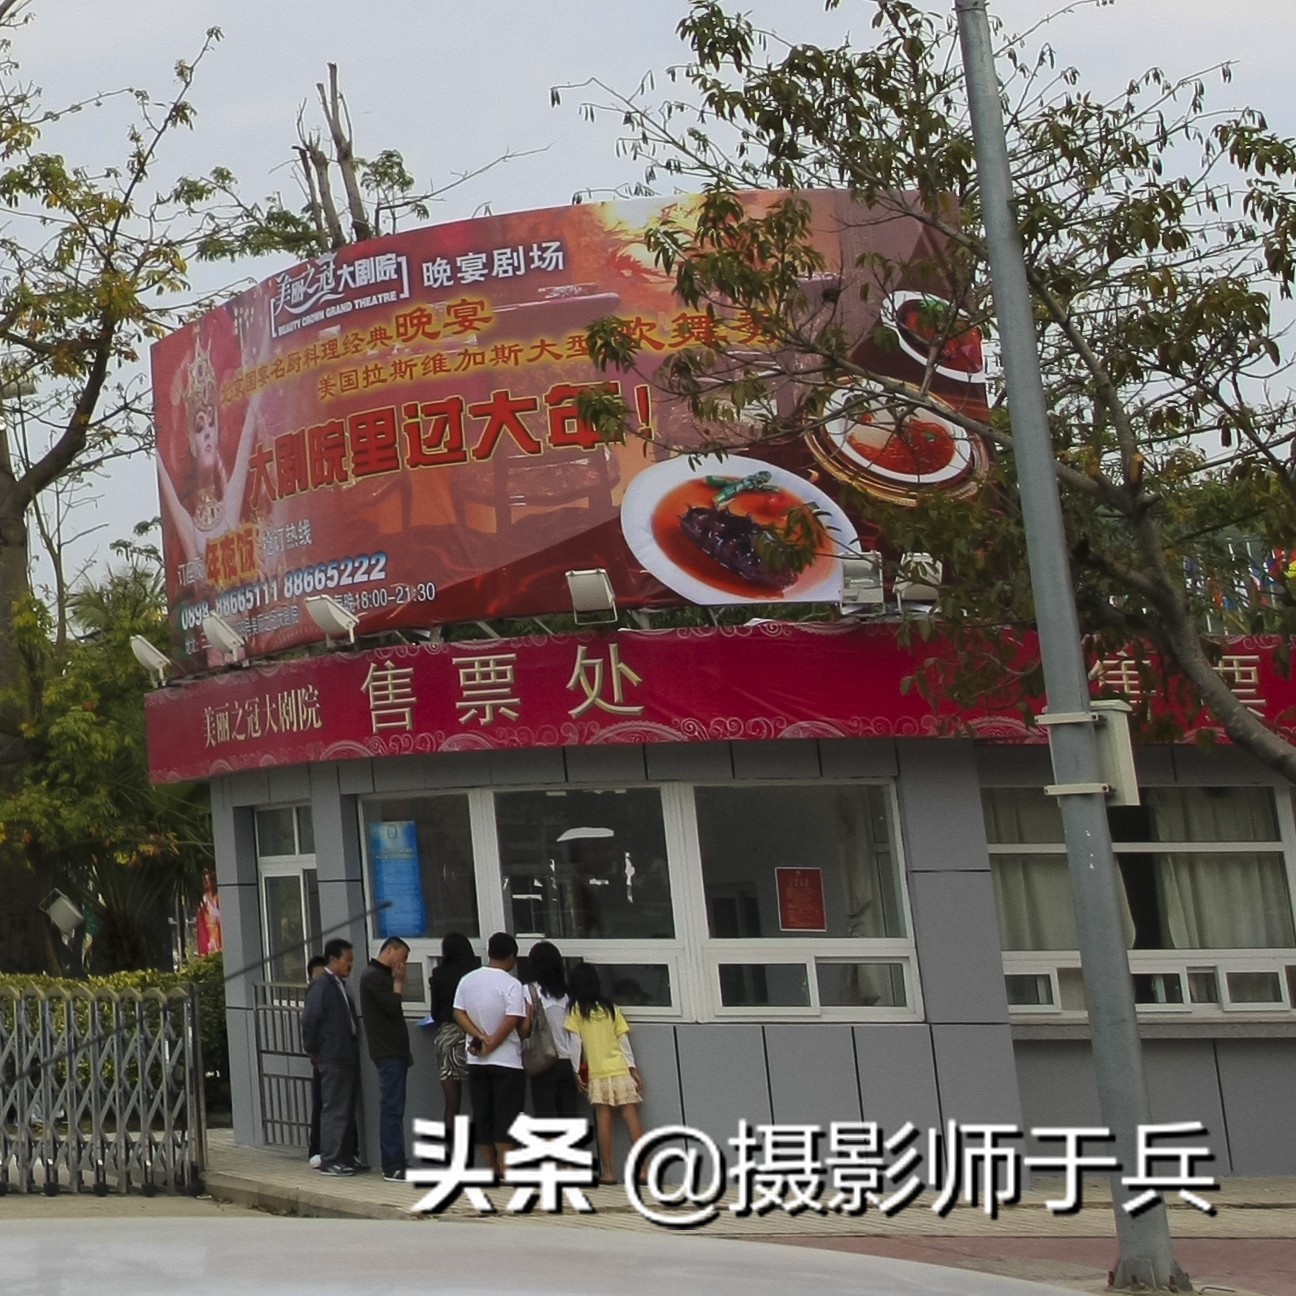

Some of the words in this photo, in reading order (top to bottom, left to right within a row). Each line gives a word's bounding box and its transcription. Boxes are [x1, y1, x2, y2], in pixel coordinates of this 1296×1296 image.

[421, 241, 565, 288] 晚宴剧场
[354, 290, 398, 310] THEATRE
[283, 551, 388, 599] 88665222
[360, 643, 645, 734] 售票处
[203, 685, 322, 749] 美丽之冠大剧院
